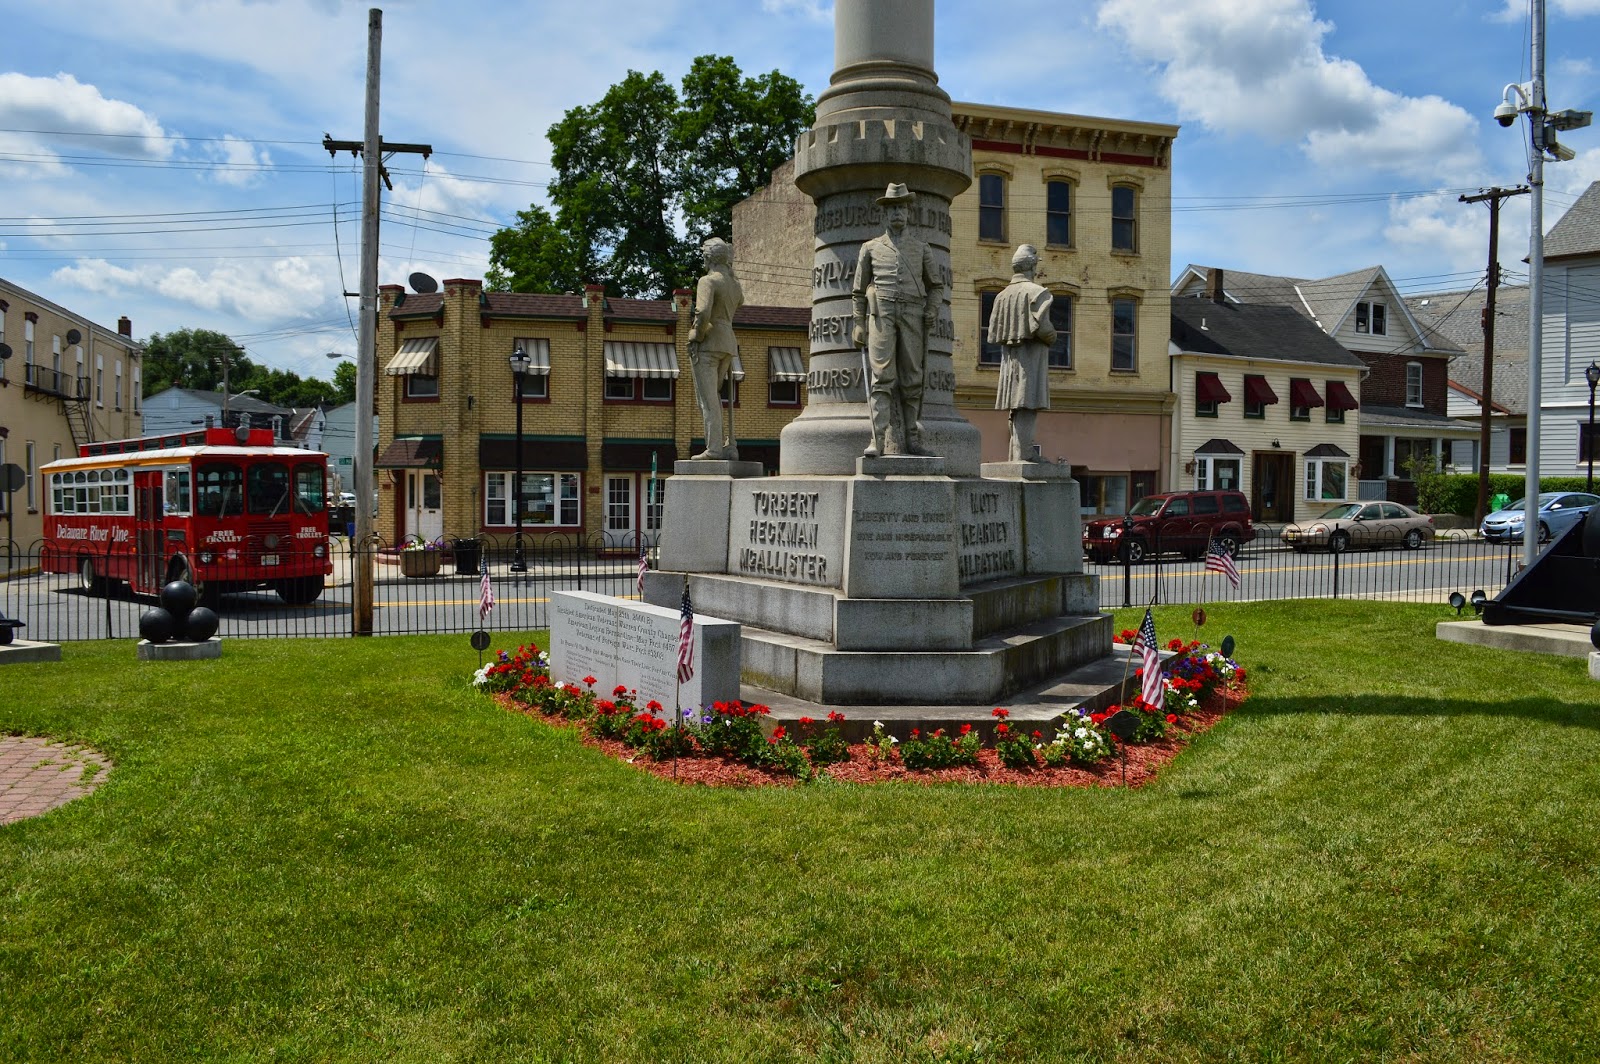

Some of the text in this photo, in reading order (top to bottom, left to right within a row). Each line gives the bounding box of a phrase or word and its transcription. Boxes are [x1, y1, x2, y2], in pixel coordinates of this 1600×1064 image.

[752, 491, 819, 519] TORBERT
[970, 492, 999, 514] MOTT
[902, 514, 920, 523] AND
[57, 524, 129, 542] Delaware River Line
[206, 535, 242, 543] TROLLEY
[296, 531, 322, 539] TROLLEY
[749, 520, 819, 549] HECKMAN
